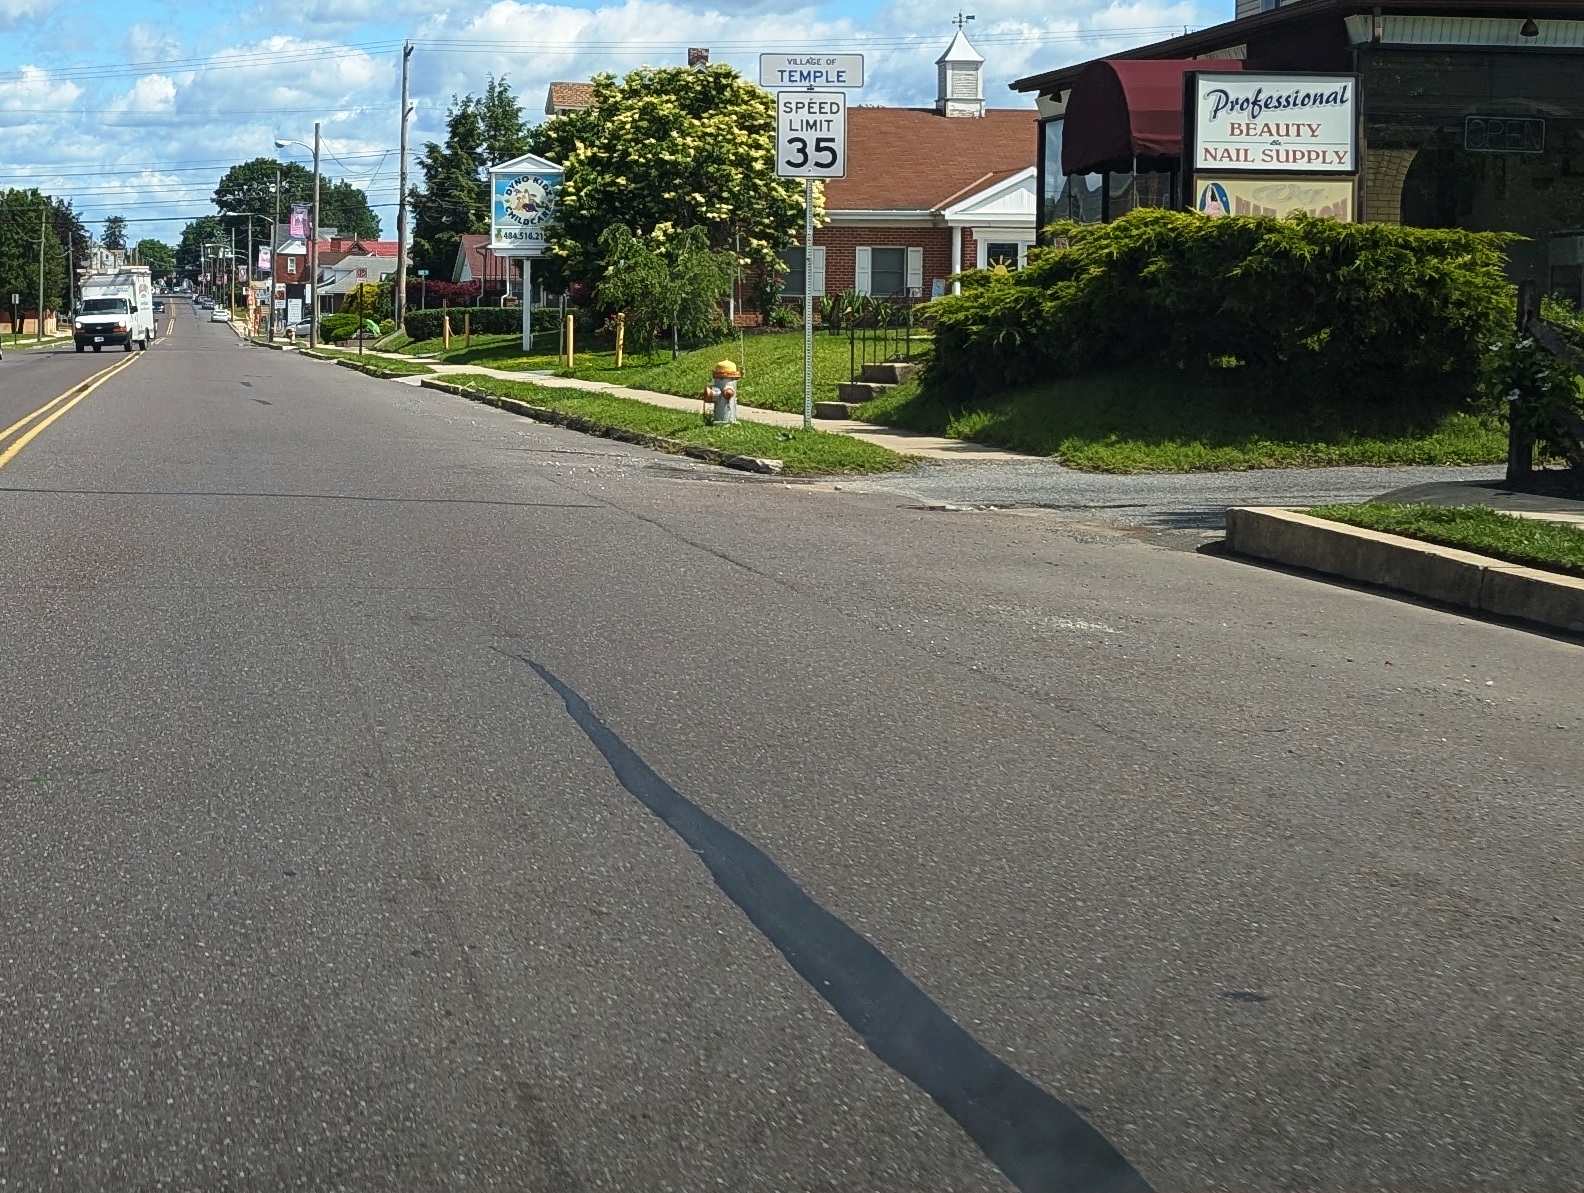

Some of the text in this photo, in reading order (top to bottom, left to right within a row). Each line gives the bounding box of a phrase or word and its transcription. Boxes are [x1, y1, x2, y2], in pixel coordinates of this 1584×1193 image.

[787, 58, 837, 66] VILLAGE OF
[777, 69, 847, 83] TEMPLE
[782, 101, 841, 115] SPEED
[1203, 84, 1349, 121] Professional
[789, 119, 834, 132] LIMIT
[1229, 122, 1322, 138] BEAUTY
[1269, 139, 1283, 147] &
[784, 136, 838, 169] 35
[1203, 147, 1349, 165] NAIL SUPPLY
[505, 175, 553, 197] DYNO KIDZ
[505, 205, 553, 226] CHILDCARE
